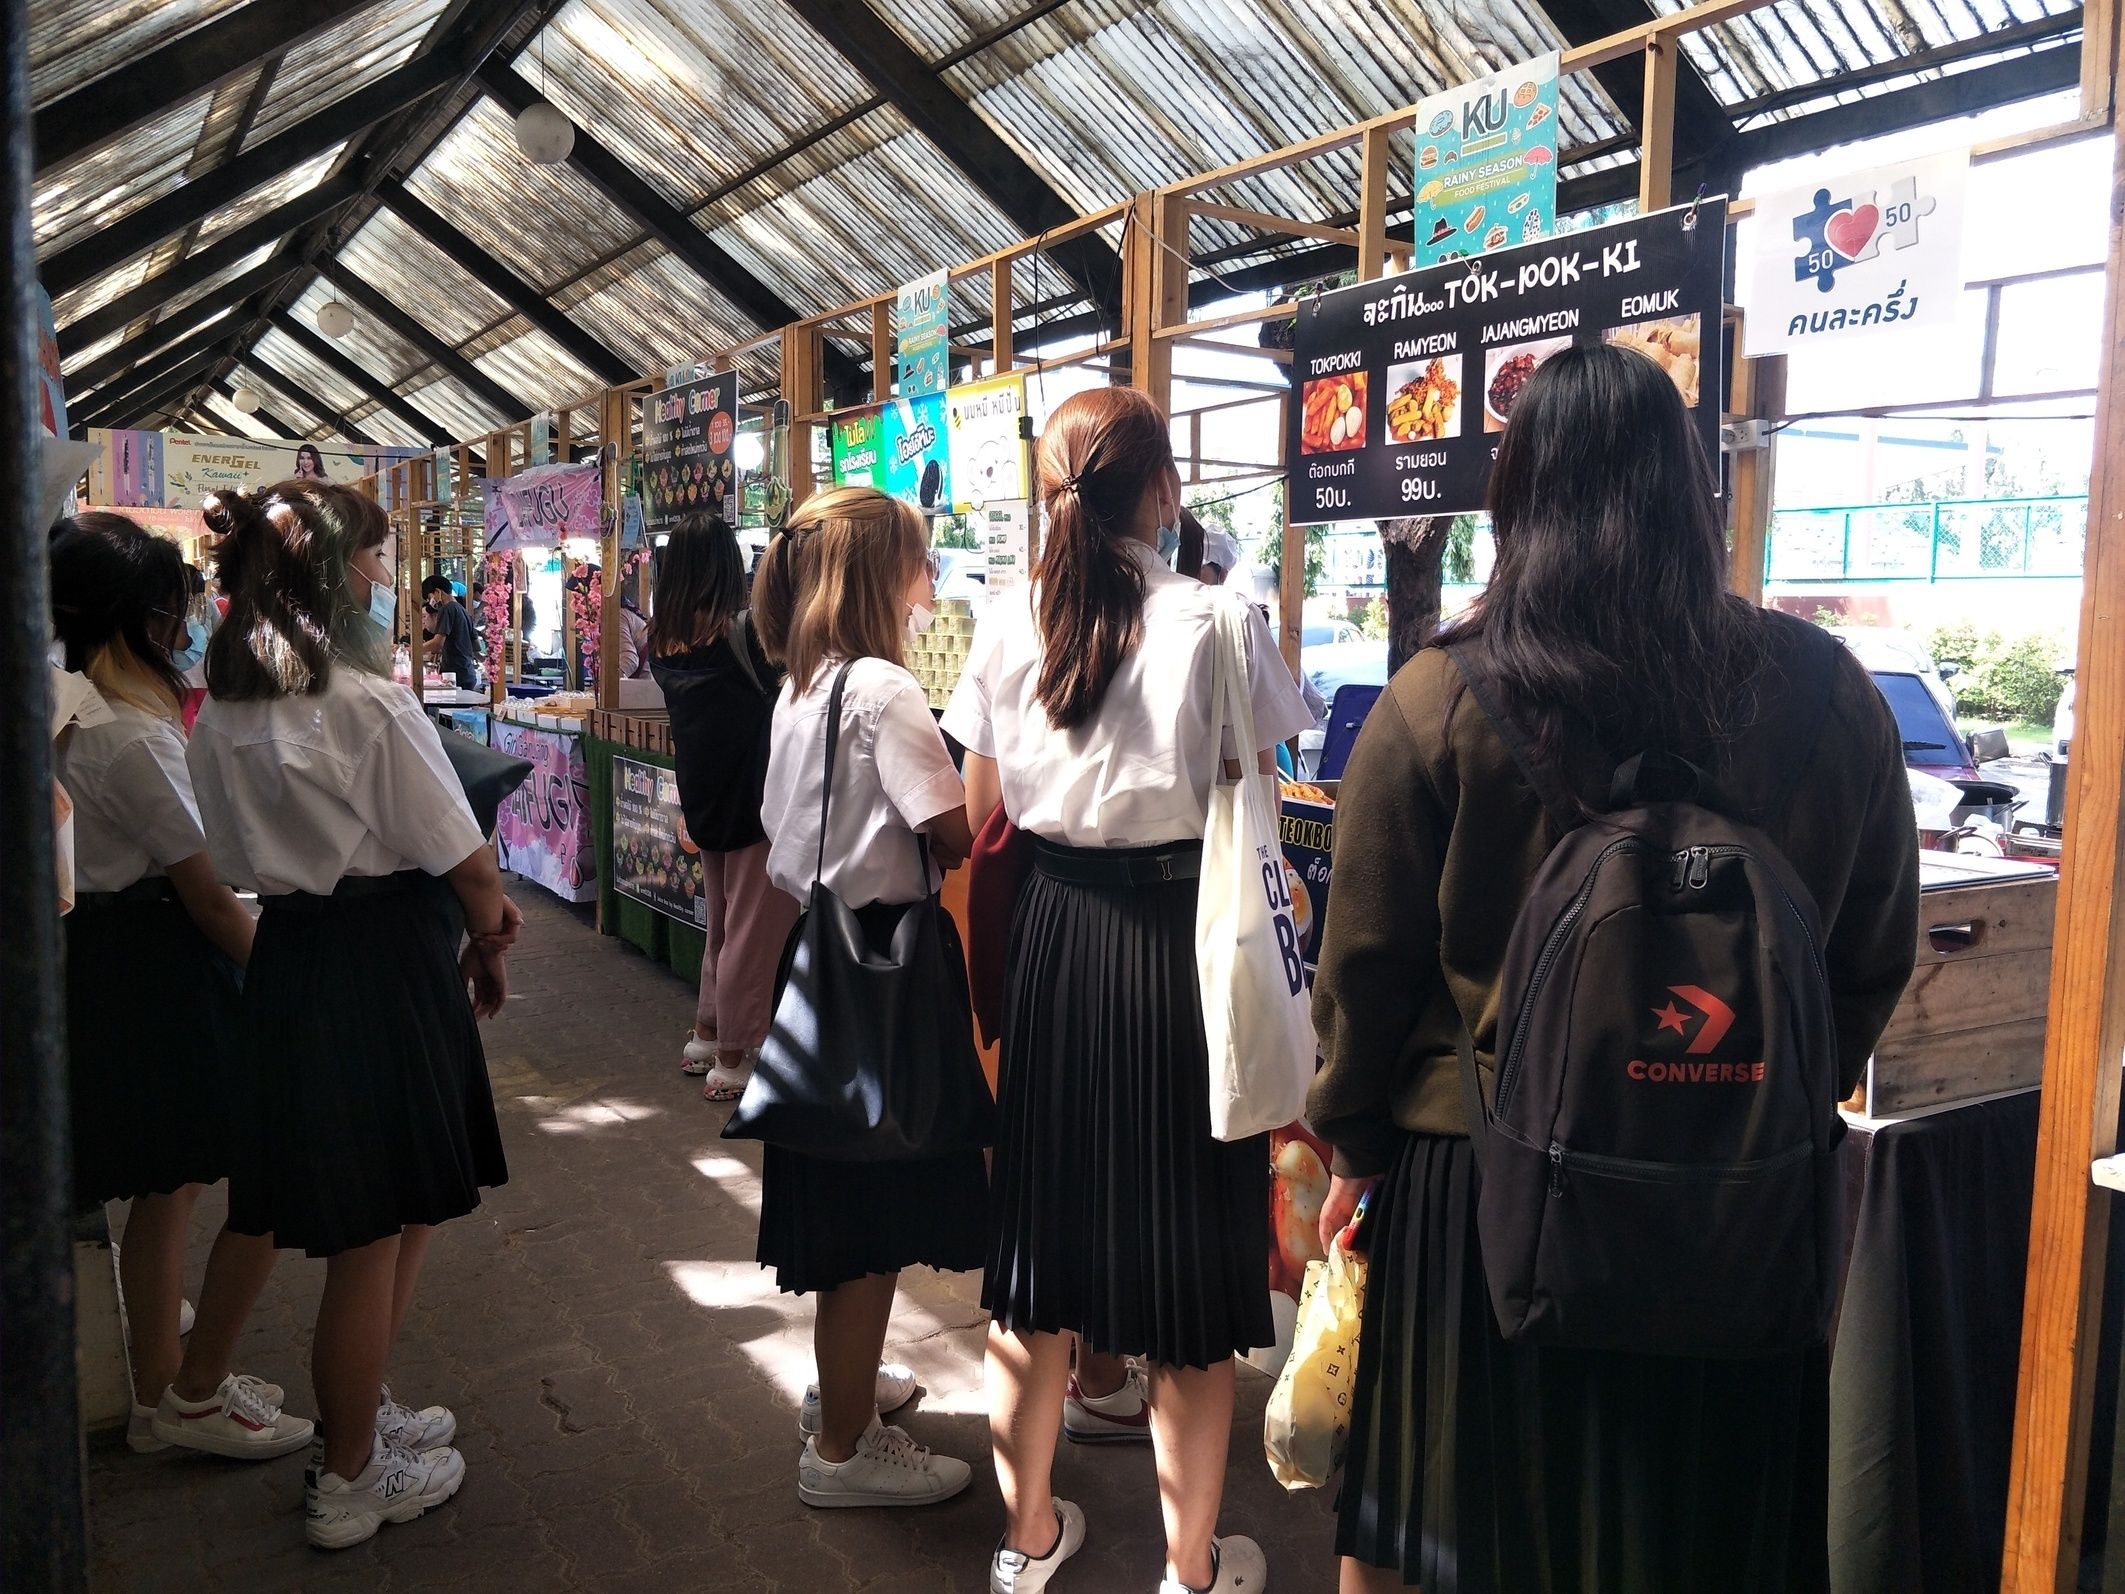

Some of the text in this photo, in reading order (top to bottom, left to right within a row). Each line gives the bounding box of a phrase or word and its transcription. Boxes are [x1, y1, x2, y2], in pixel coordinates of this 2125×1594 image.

[1462, 88, 1508, 141] KU
[1443, 157, 1524, 188] RAINY SEASON
[1454, 178, 1511, 198] FOOD FESTIVAL
[1885, 202, 1911, 228] 50
[1808, 249, 1834, 274] 50
[914, 286, 930, 316] KU
[1621, 288, 1680, 318] EOMUK
[1787, 279, 1919, 337] คนละครึ่ง
[1480, 308, 1580, 344] JAJANGMYEON
[1394, 332, 1458, 360] RAMYEON
[1310, 351, 1362, 375] TOKPOKKI
[655, 387, 721, 424] Healthy Corner
[169, 437, 192, 446] Pentel
[191, 454, 261, 470] ENERGEL
[1395, 451, 1448, 472] รามยอน
[624, 767, 654, 803] Healthy
[1256, 845, 1269, 861] THE
[1626, 1059, 1766, 1083] CONVERSE
